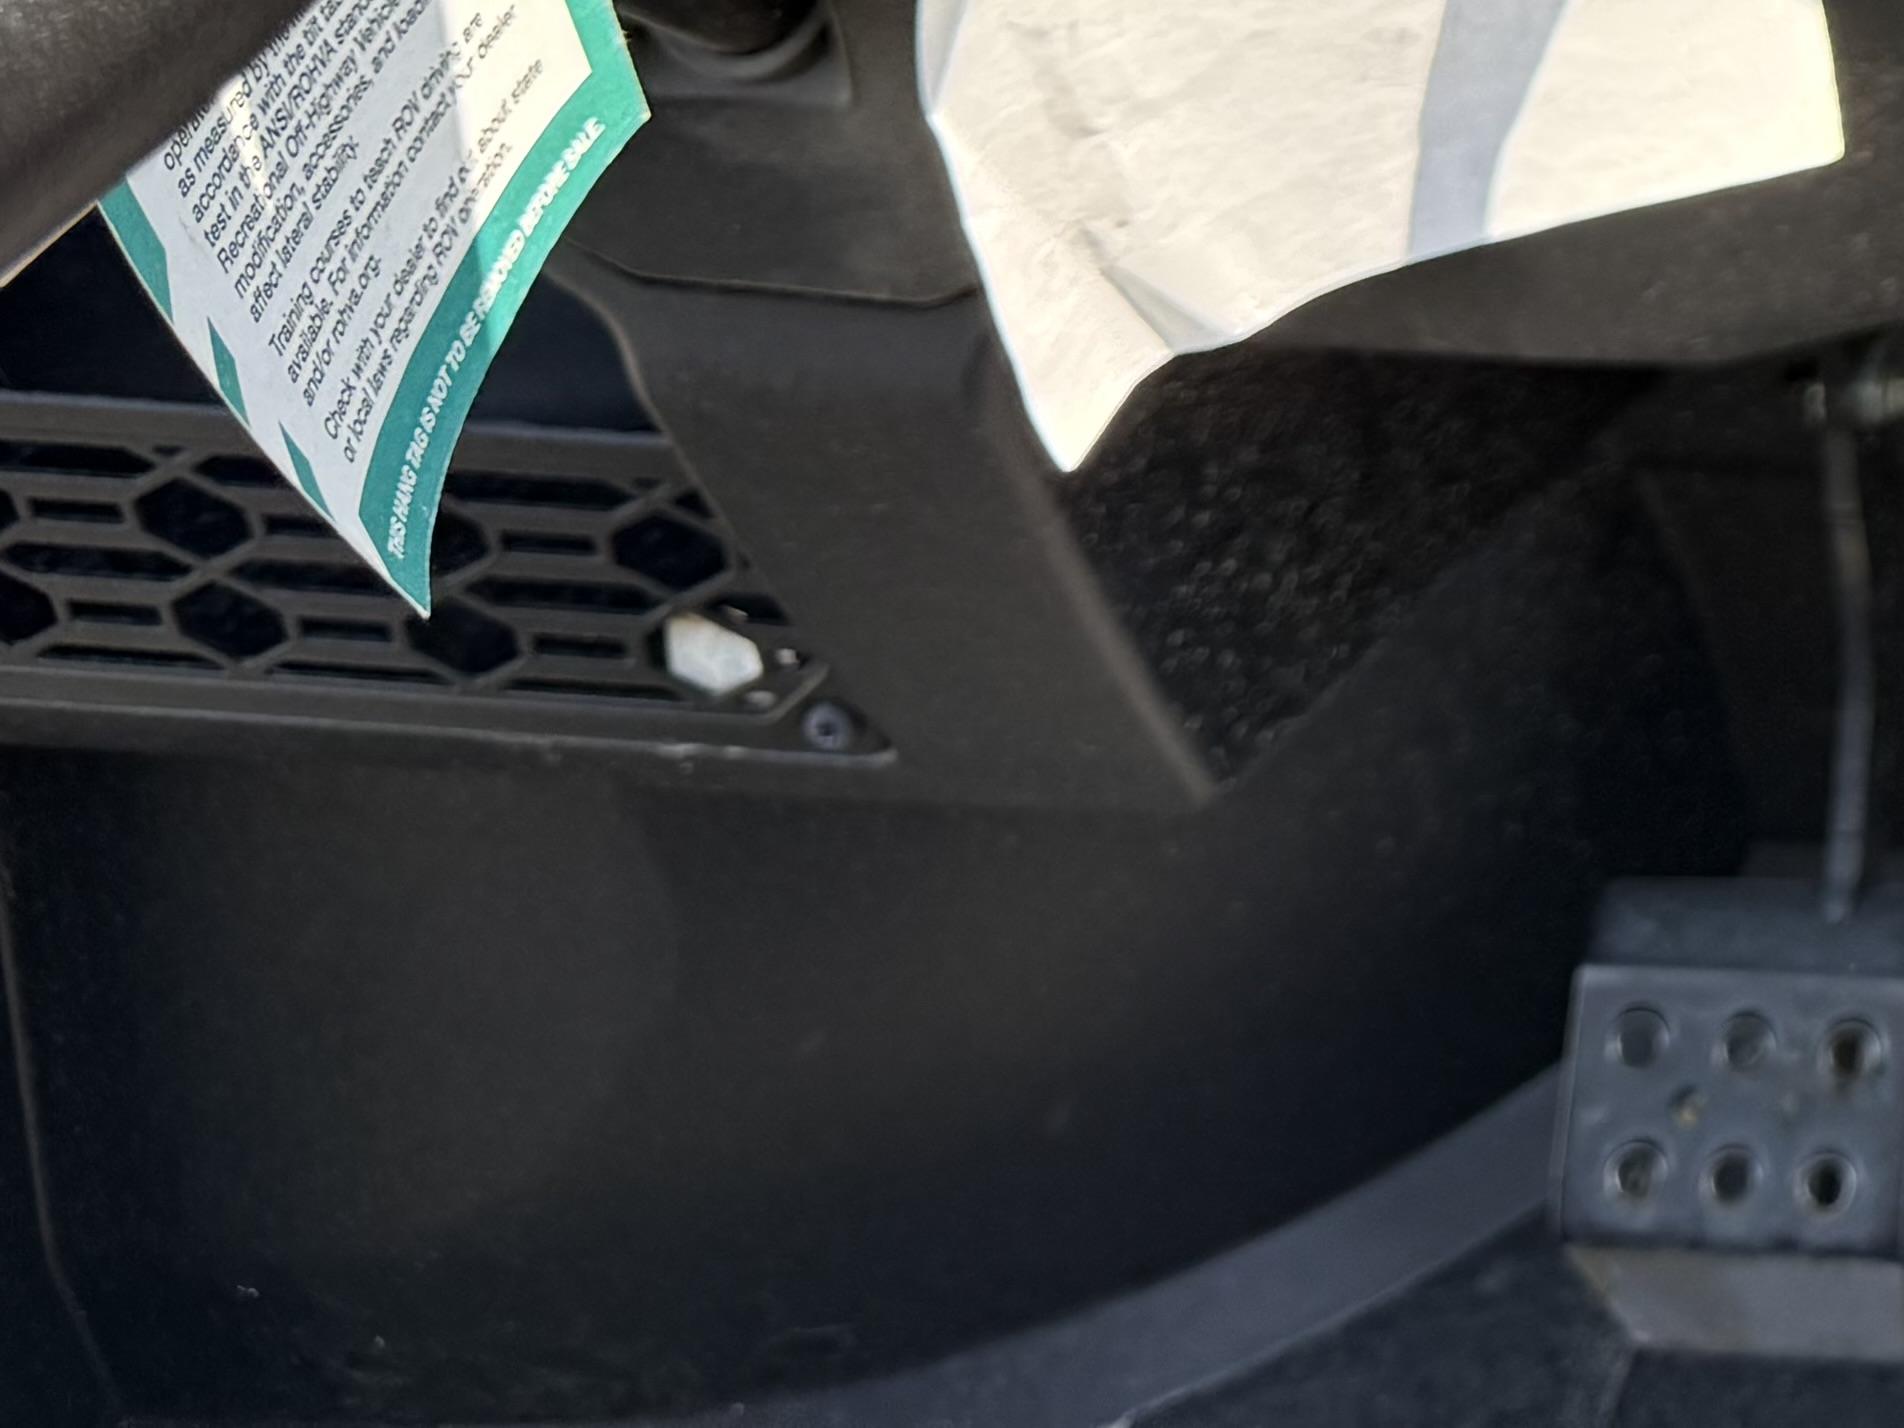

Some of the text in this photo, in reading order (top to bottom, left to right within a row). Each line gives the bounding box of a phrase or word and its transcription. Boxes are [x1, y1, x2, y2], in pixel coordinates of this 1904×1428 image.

[175, 164, 198, 198] as
[191, 68, 255, 172] measured
[188, 112, 260, 222] accordance
[255, 69, 287, 116] with
[281, 42, 307, 77] the
[232, 176, 304, 298] modification,
[369, 28, 398, 74] and
[202, 203, 231, 247] test
[223, 183, 244, 210] in
[236, 152, 264, 188] the
[247, 258, 282, 323] affect
[273, 201, 314, 268] lateral
[269, 280, 313, 357] Training
[308, 208, 354, 285] courses
[348, 184, 368, 211] to
[390, 89, 424, 140] ROV
[286, 293, 334, 383] available.
[326, 256, 351, 296] For
[302, 340, 336, 407] and/or
[323, 373, 358, 439] Check
[351, 334, 375, 380] with
[421, 212, 440, 240] to
[343, 437, 357, 463] or
[347, 386, 375, 442] local
[392, 465, 418, 522] HANG
[405, 427, 429, 469] TAG
[426, 365, 453, 413] NOT
[446, 340, 466, 372] TO
[459, 311, 481, 348] BE
